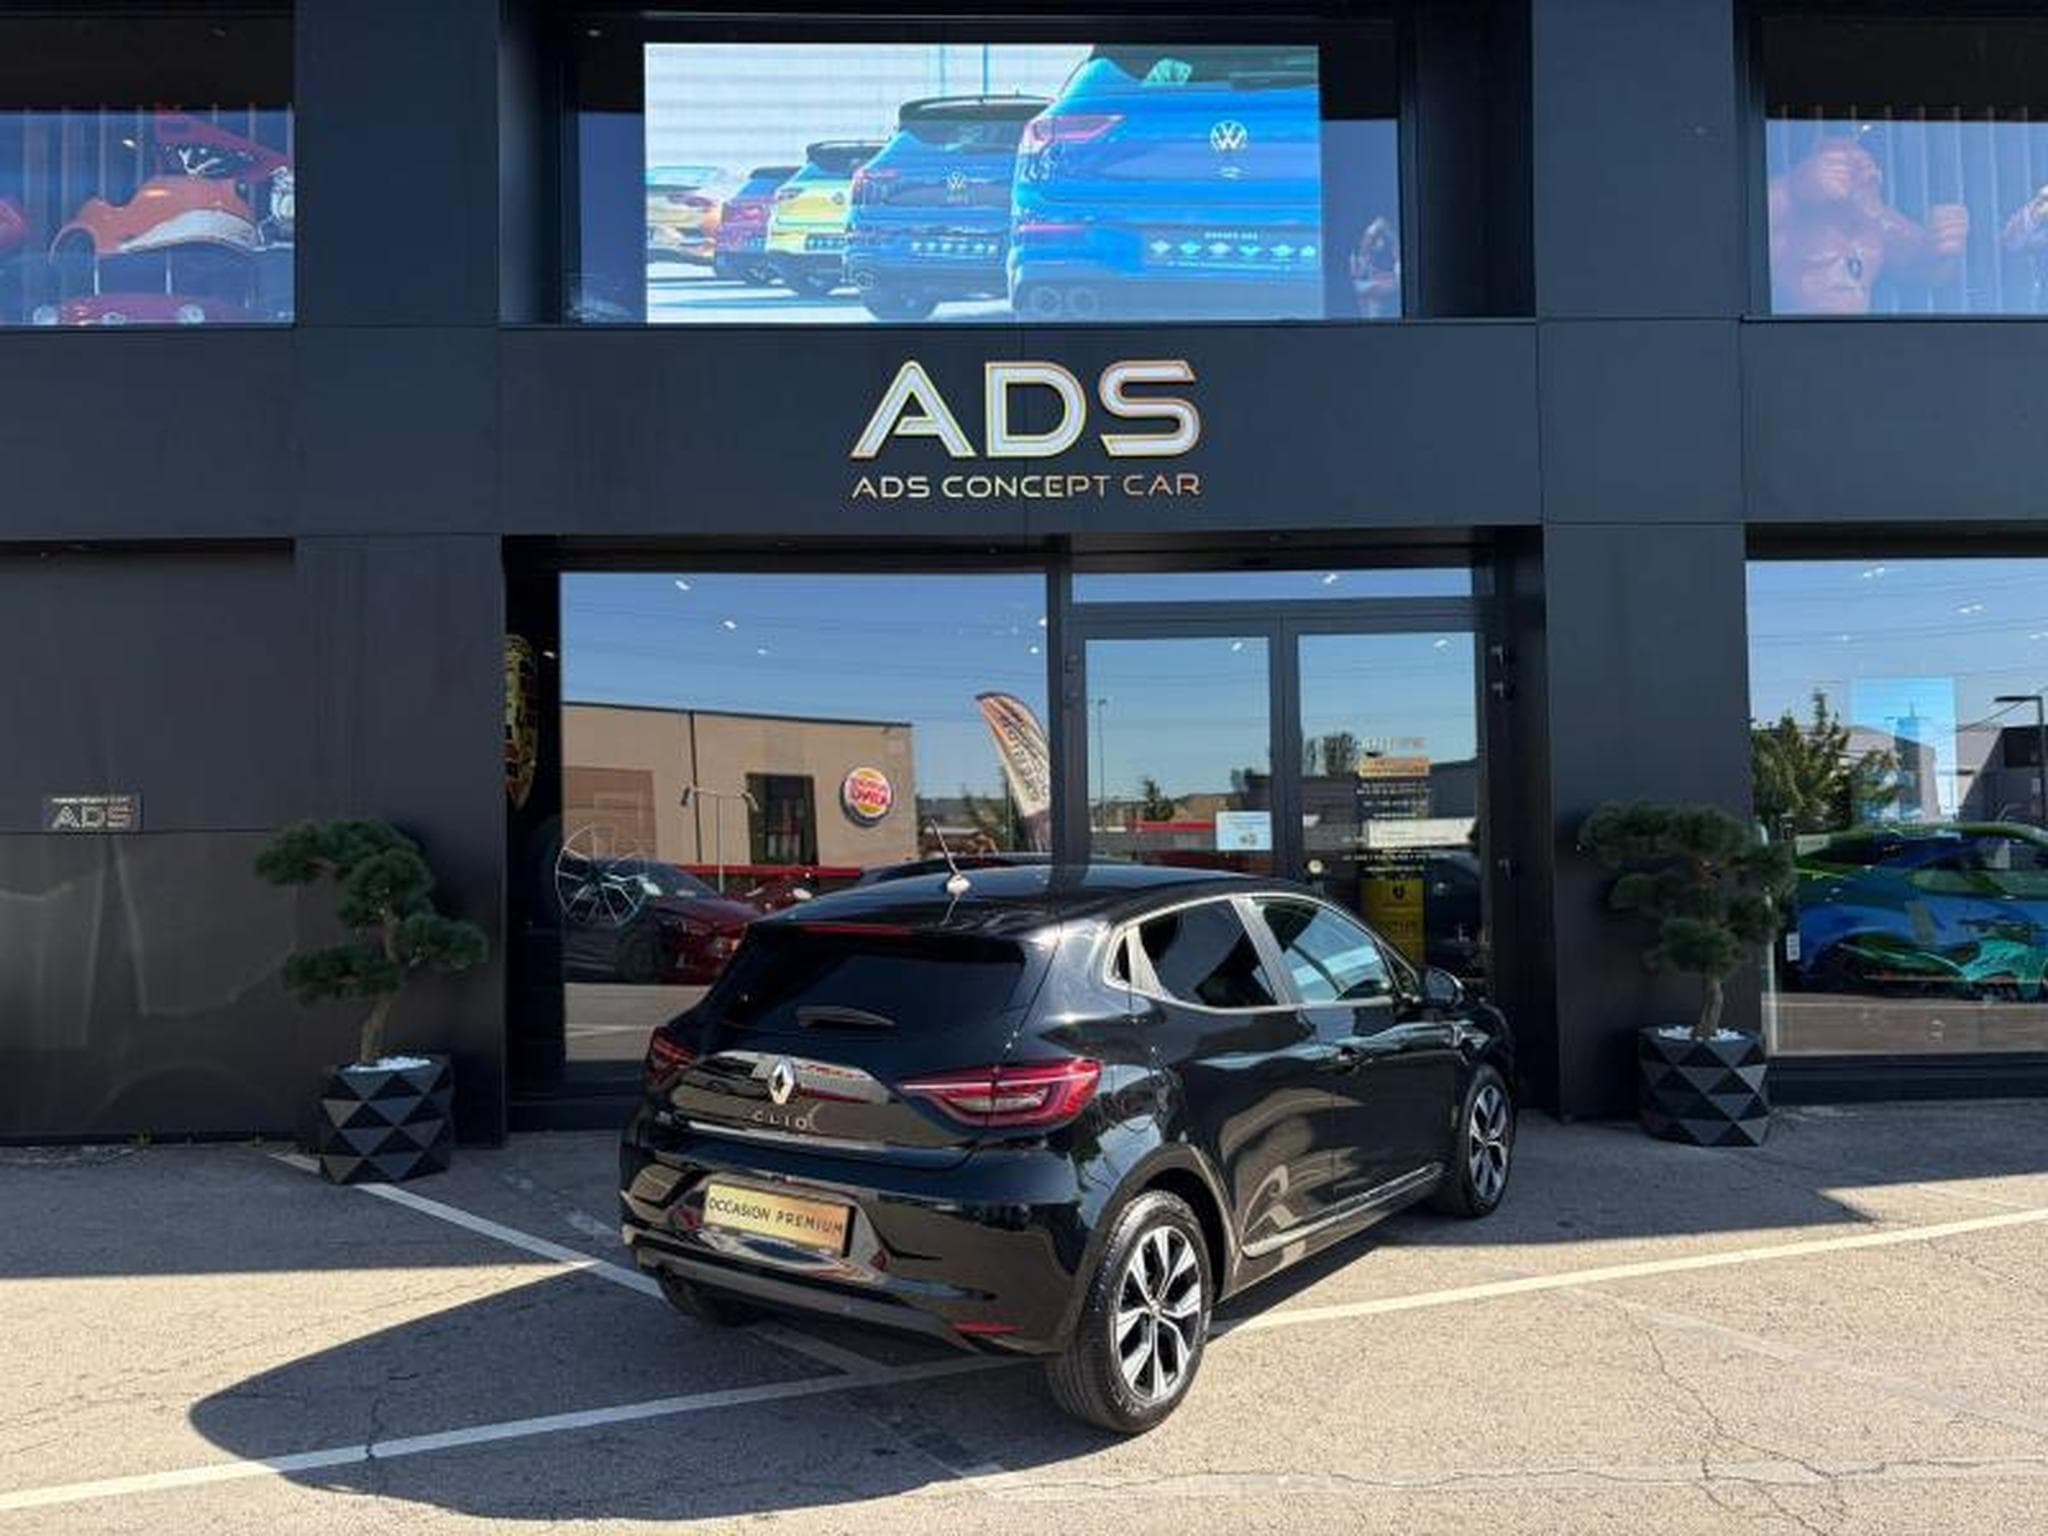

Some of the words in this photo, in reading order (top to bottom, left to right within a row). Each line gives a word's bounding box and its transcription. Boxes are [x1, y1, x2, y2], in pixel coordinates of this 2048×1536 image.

[850, 359, 1200, 458] ADS
[851, 476, 930, 498] ADS
[942, 475, 1110, 498] CONCEPT
[1122, 473, 1201, 497] CAR
[51, 804, 132, 828] ADS
[753, 1109, 808, 1130] CLIO
[708, 1196, 772, 1222] OCCASION
[774, 1210, 844, 1235] PREMIUM
